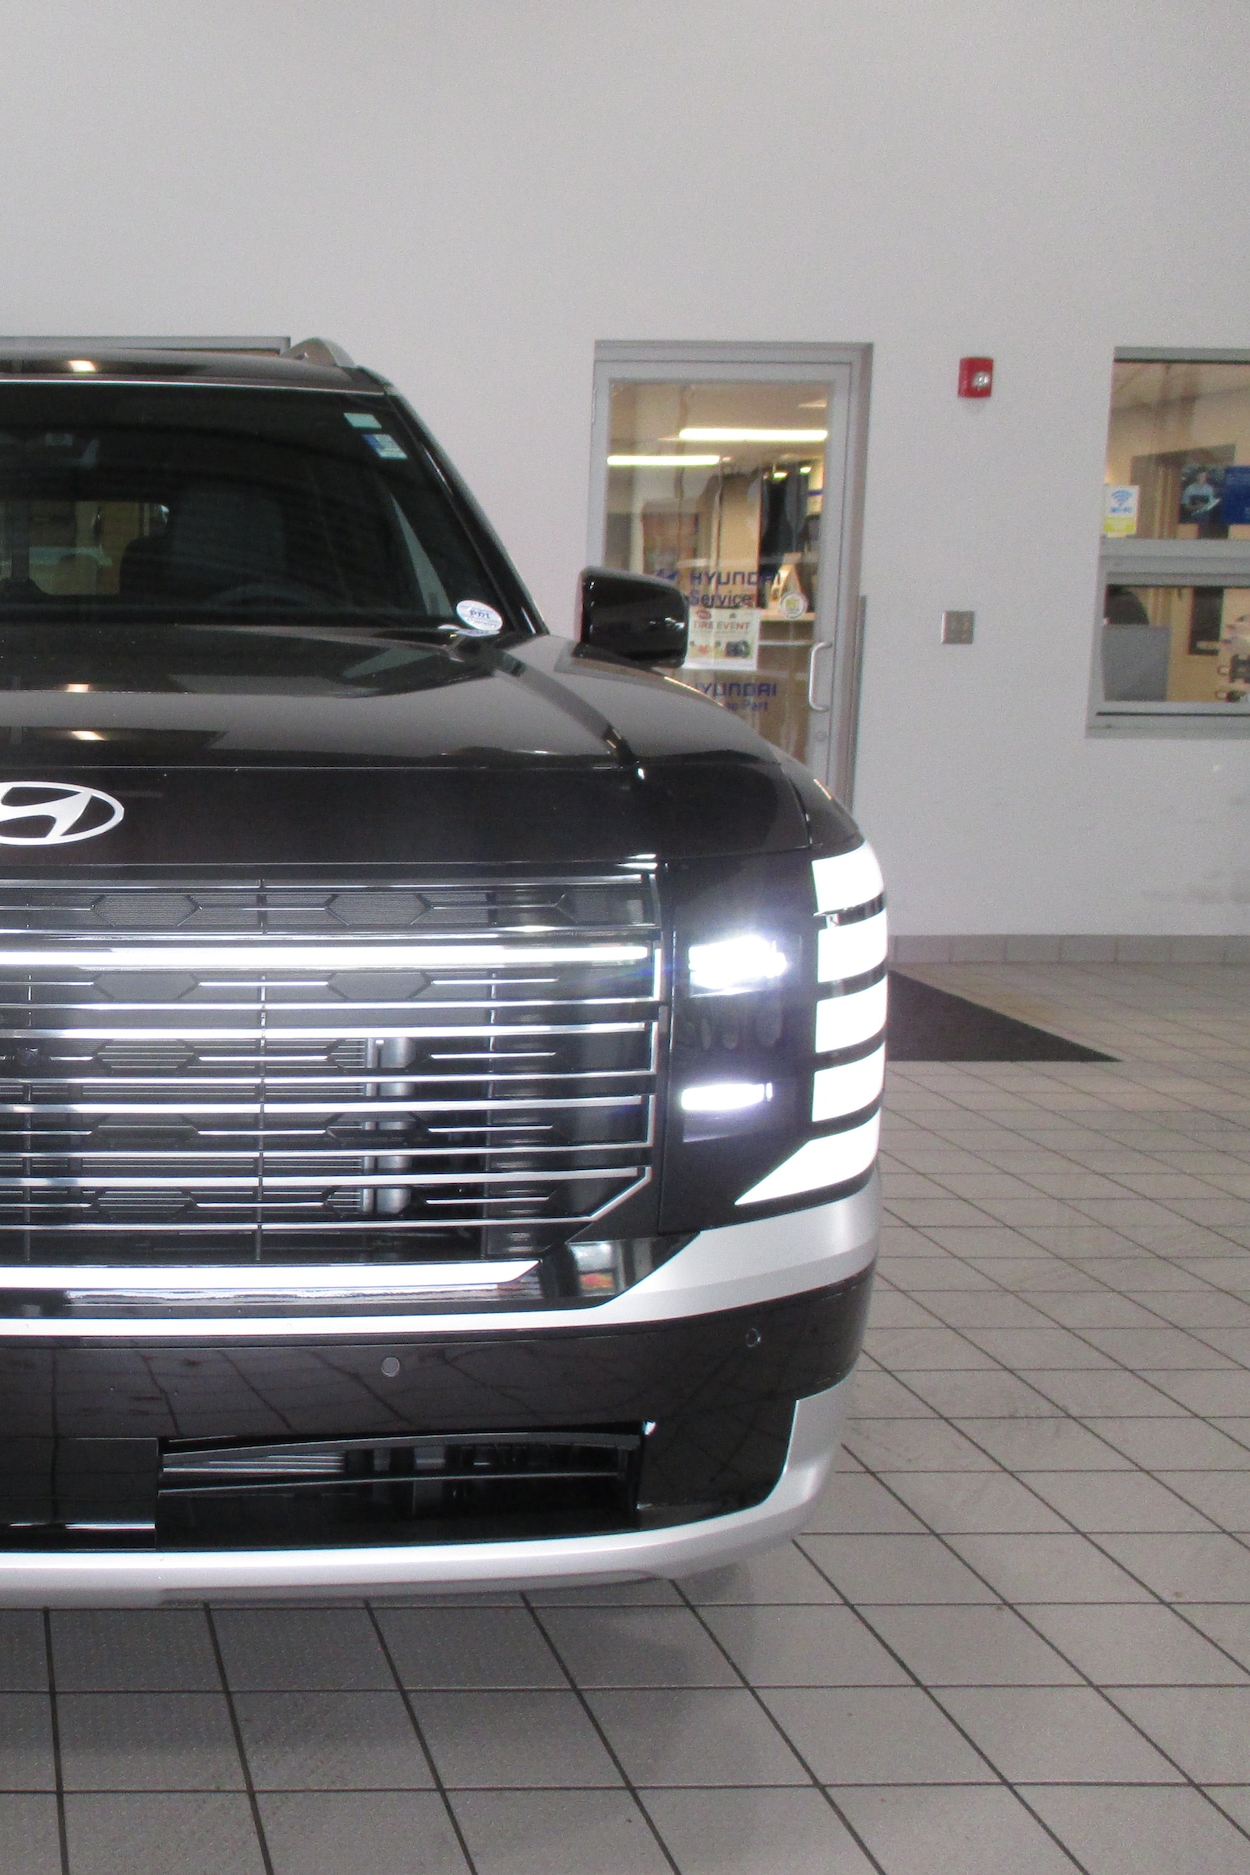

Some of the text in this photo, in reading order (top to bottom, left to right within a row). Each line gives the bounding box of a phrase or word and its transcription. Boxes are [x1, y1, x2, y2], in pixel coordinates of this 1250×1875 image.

[689, 571, 781, 586] HYUNDAI
[689, 588, 752, 607] Service
[716, 621, 750, 630] EVENT
[694, 682, 777, 696] YUNDAI
